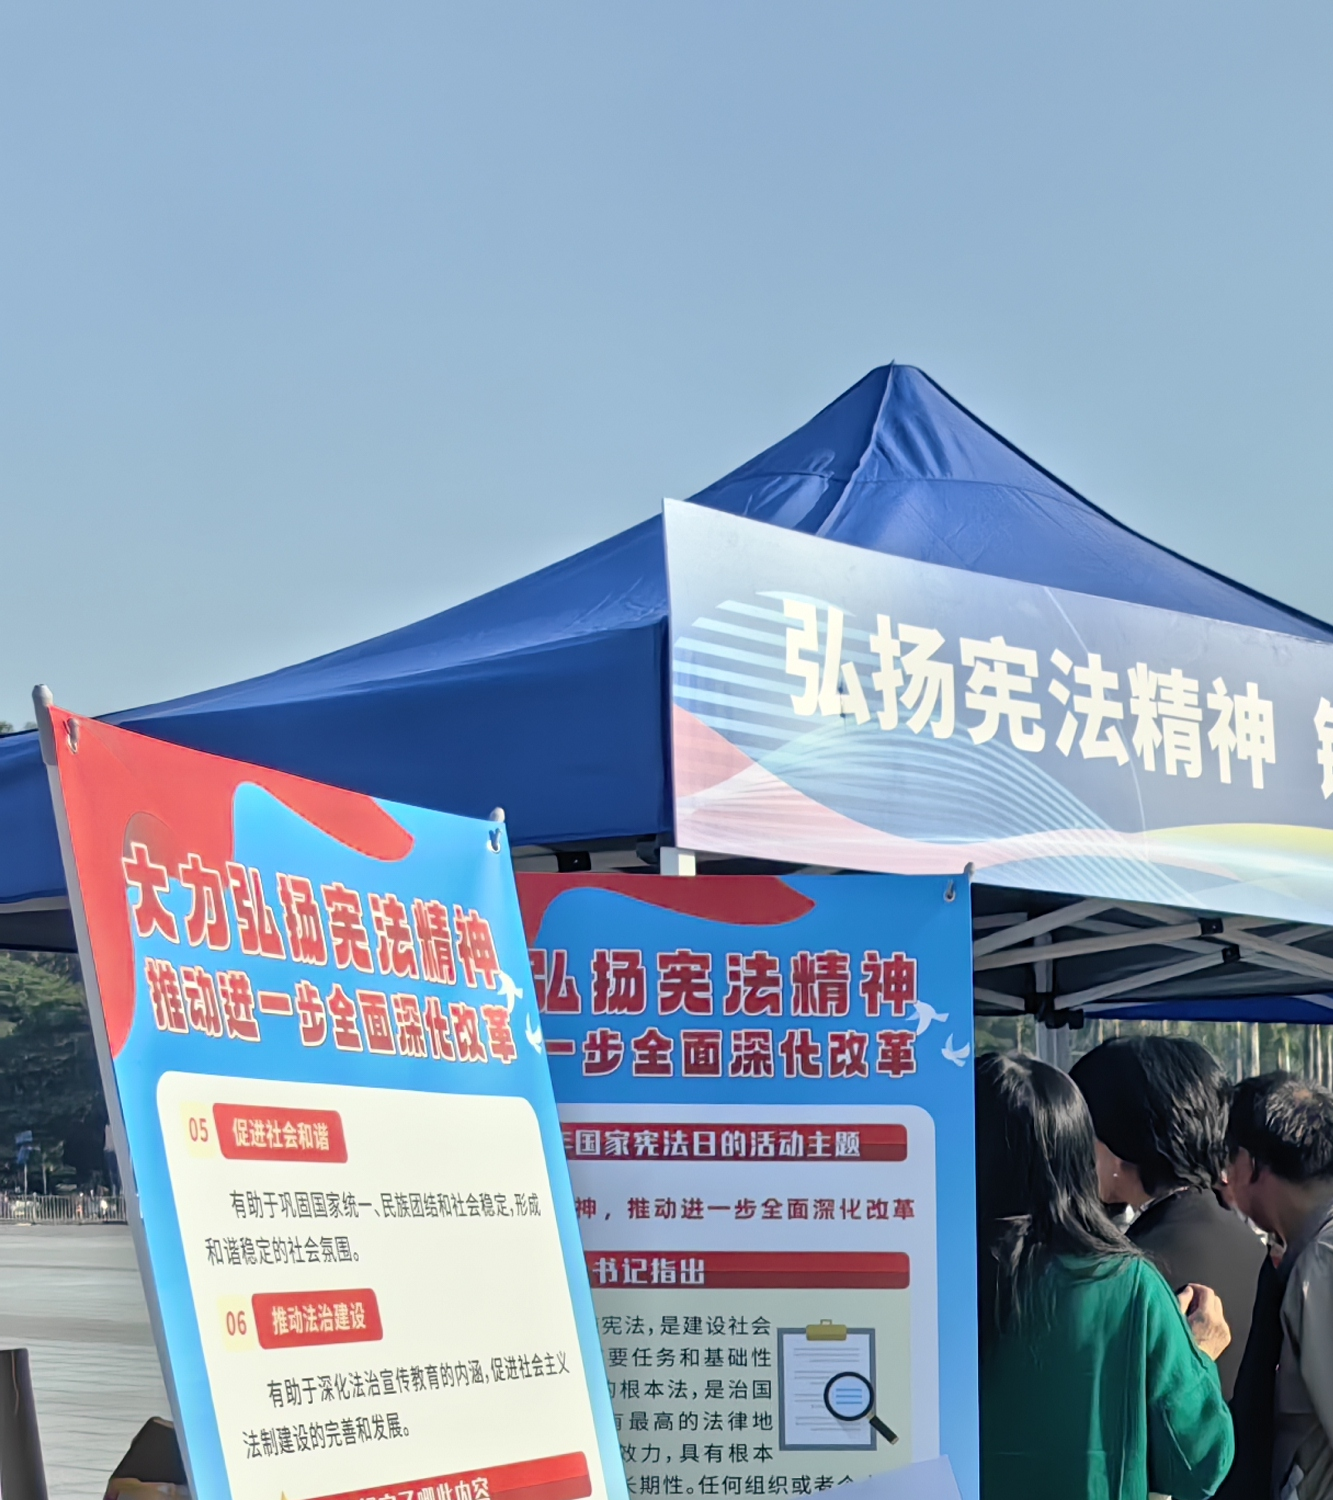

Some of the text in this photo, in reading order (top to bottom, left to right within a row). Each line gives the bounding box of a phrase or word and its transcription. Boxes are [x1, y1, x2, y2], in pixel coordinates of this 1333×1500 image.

[783, 599, 1275, 789] 弘扬宪法精神
[123, 841, 502, 990] 大力弘扬宪法精神
[144, 957, 517, 1064] 推动进一步全面深化改革
[189, 1117, 208, 1142] 05
[232, 1118, 330, 1151] 促进社会和谐
[205, 1236, 359, 1266] 和谐稳定的社会氛围。
[590, 1257, 705, 1285] 书记指出
[225, 1311, 247, 1336] 06
[271, 1302, 366, 1336] 推动法治建设
[596, 1314, 772, 1337] 宪法，是建设社会
[242, 1412, 410, 1459] 法制建设的完善和发展。
